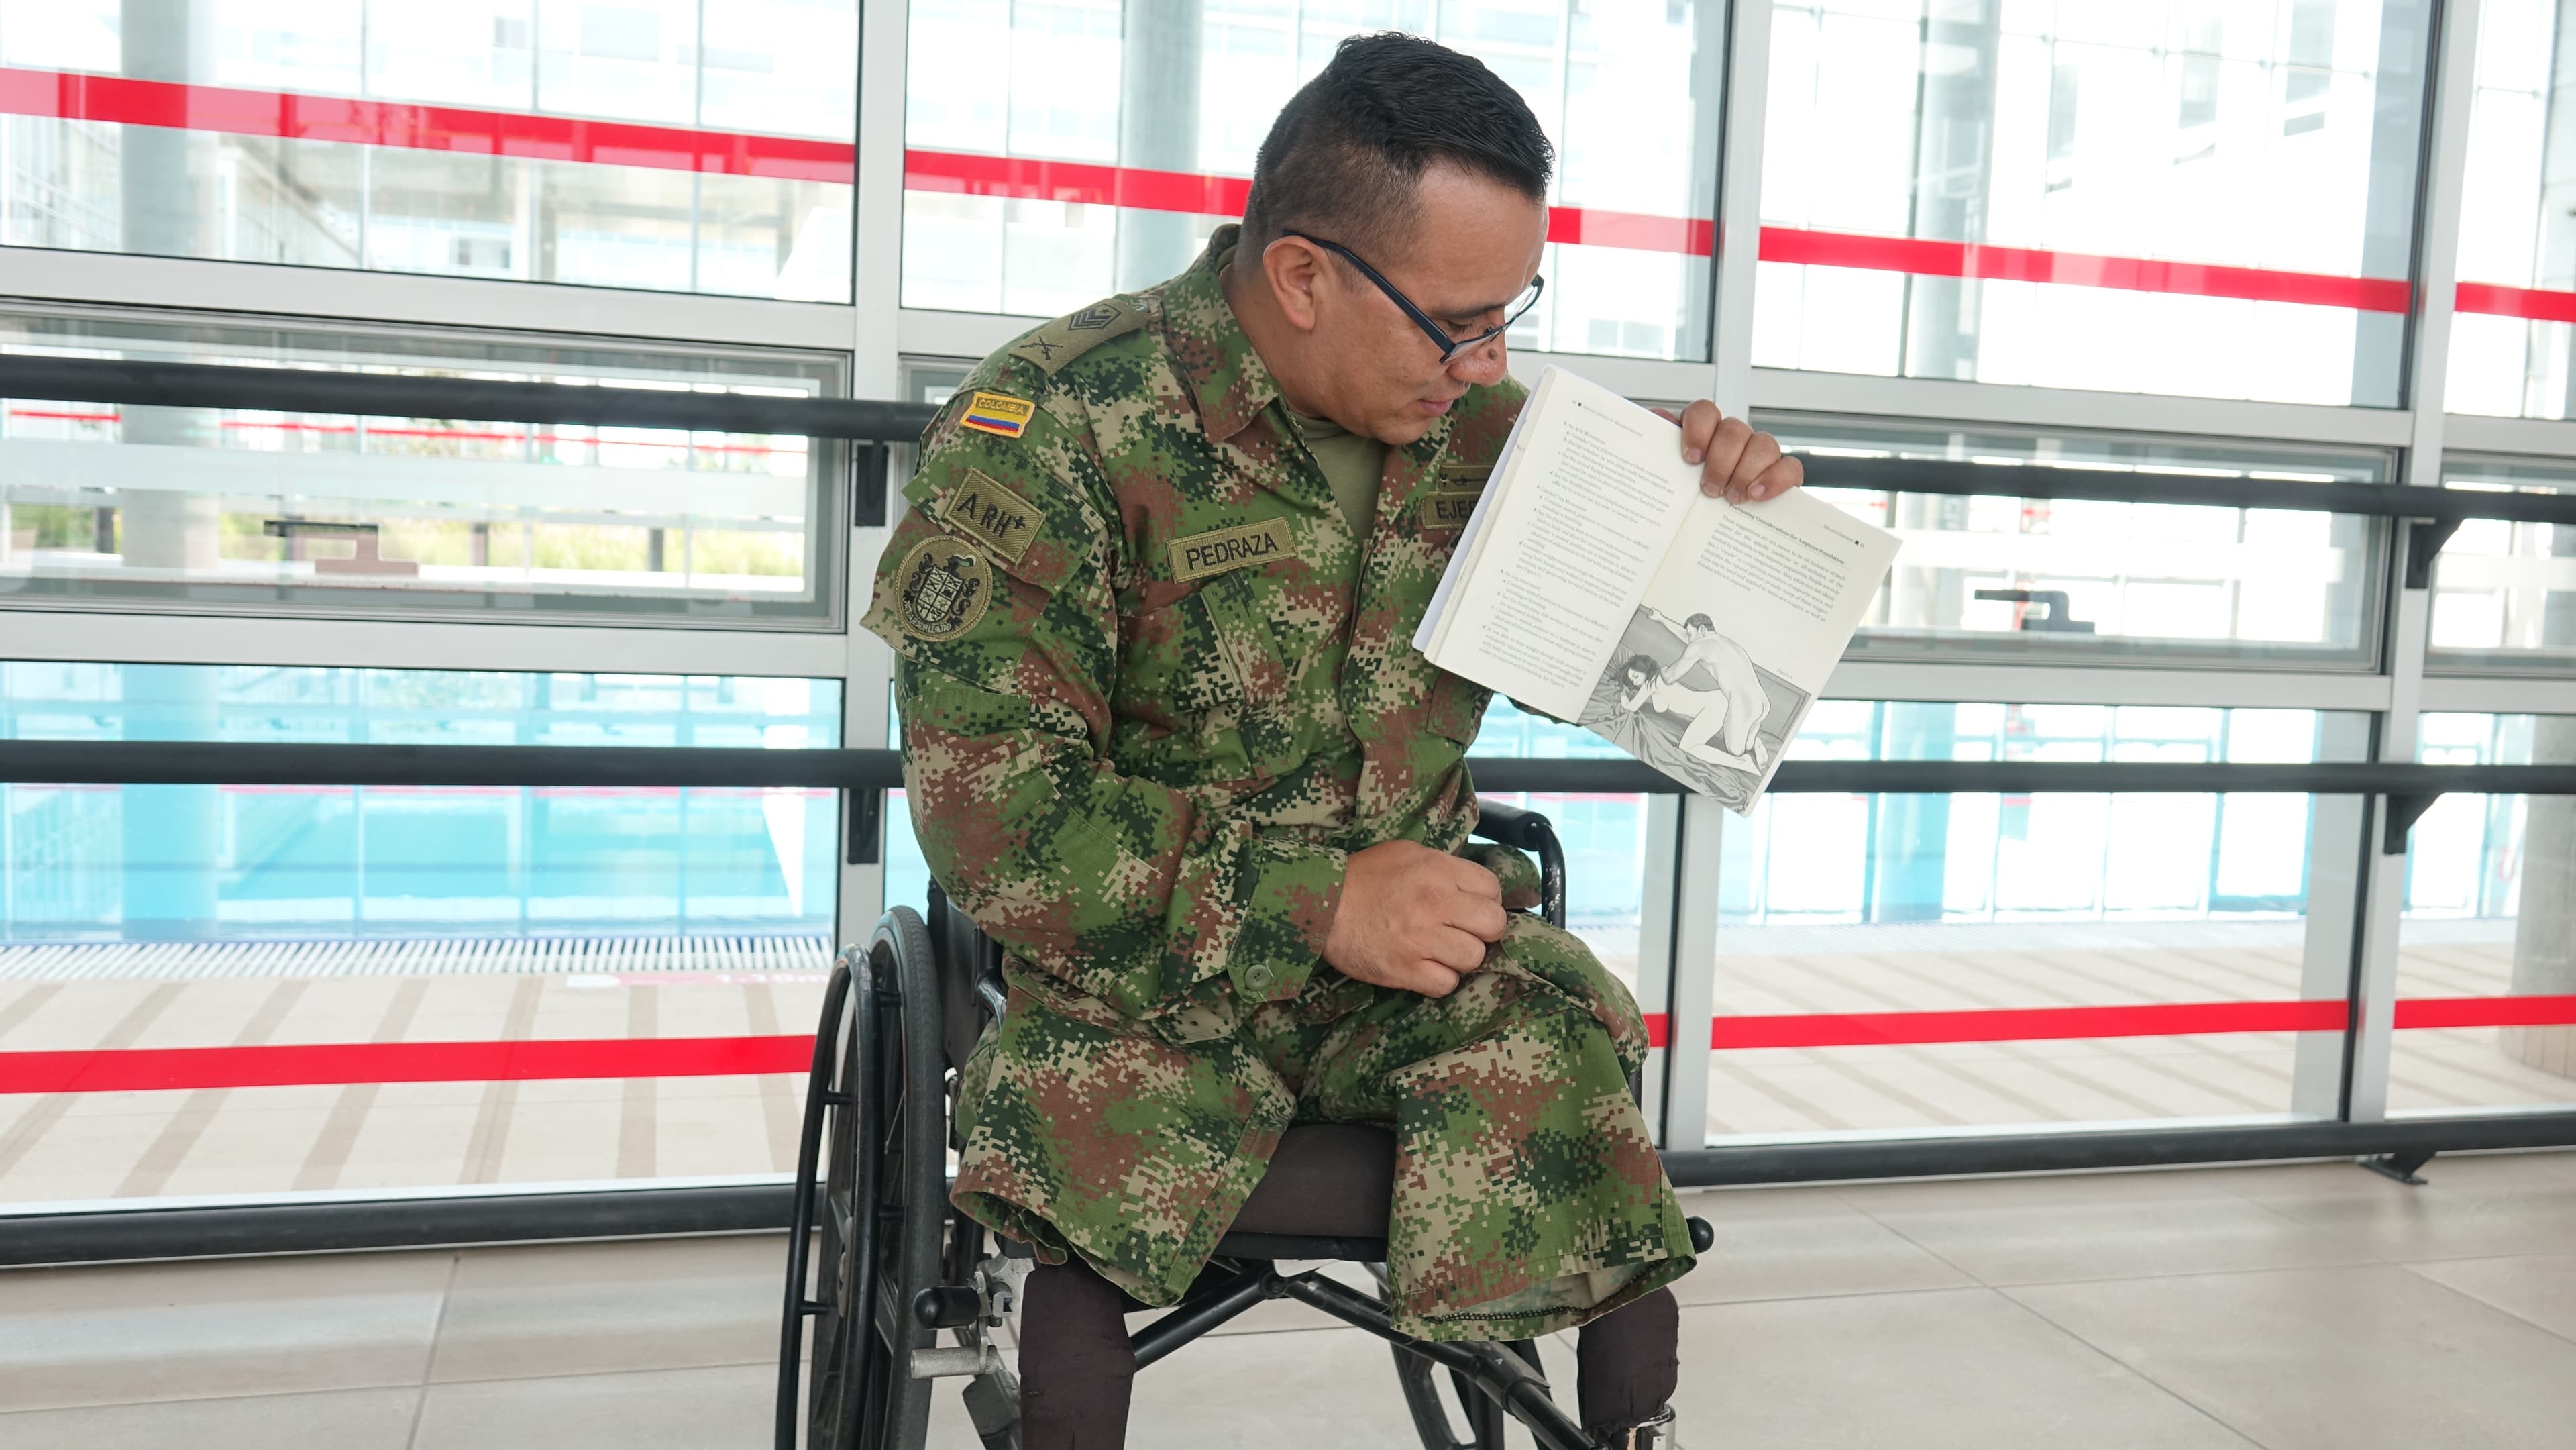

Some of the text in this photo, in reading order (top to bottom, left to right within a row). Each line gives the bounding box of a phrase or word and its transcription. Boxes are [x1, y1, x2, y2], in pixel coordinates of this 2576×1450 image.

[979, 398, 1024, 415] COLOMBIA
[957, 493, 977, 519] A
[1729, 503, 1756, 519] Positioning
[1755, 515, 1790, 537] Considerations
[1789, 532, 1798, 541] for
[1797, 536, 1819, 552] Amputee
[1819, 547, 1845, 564] Population
[1185, 532, 1279, 570] PEDRAZA
